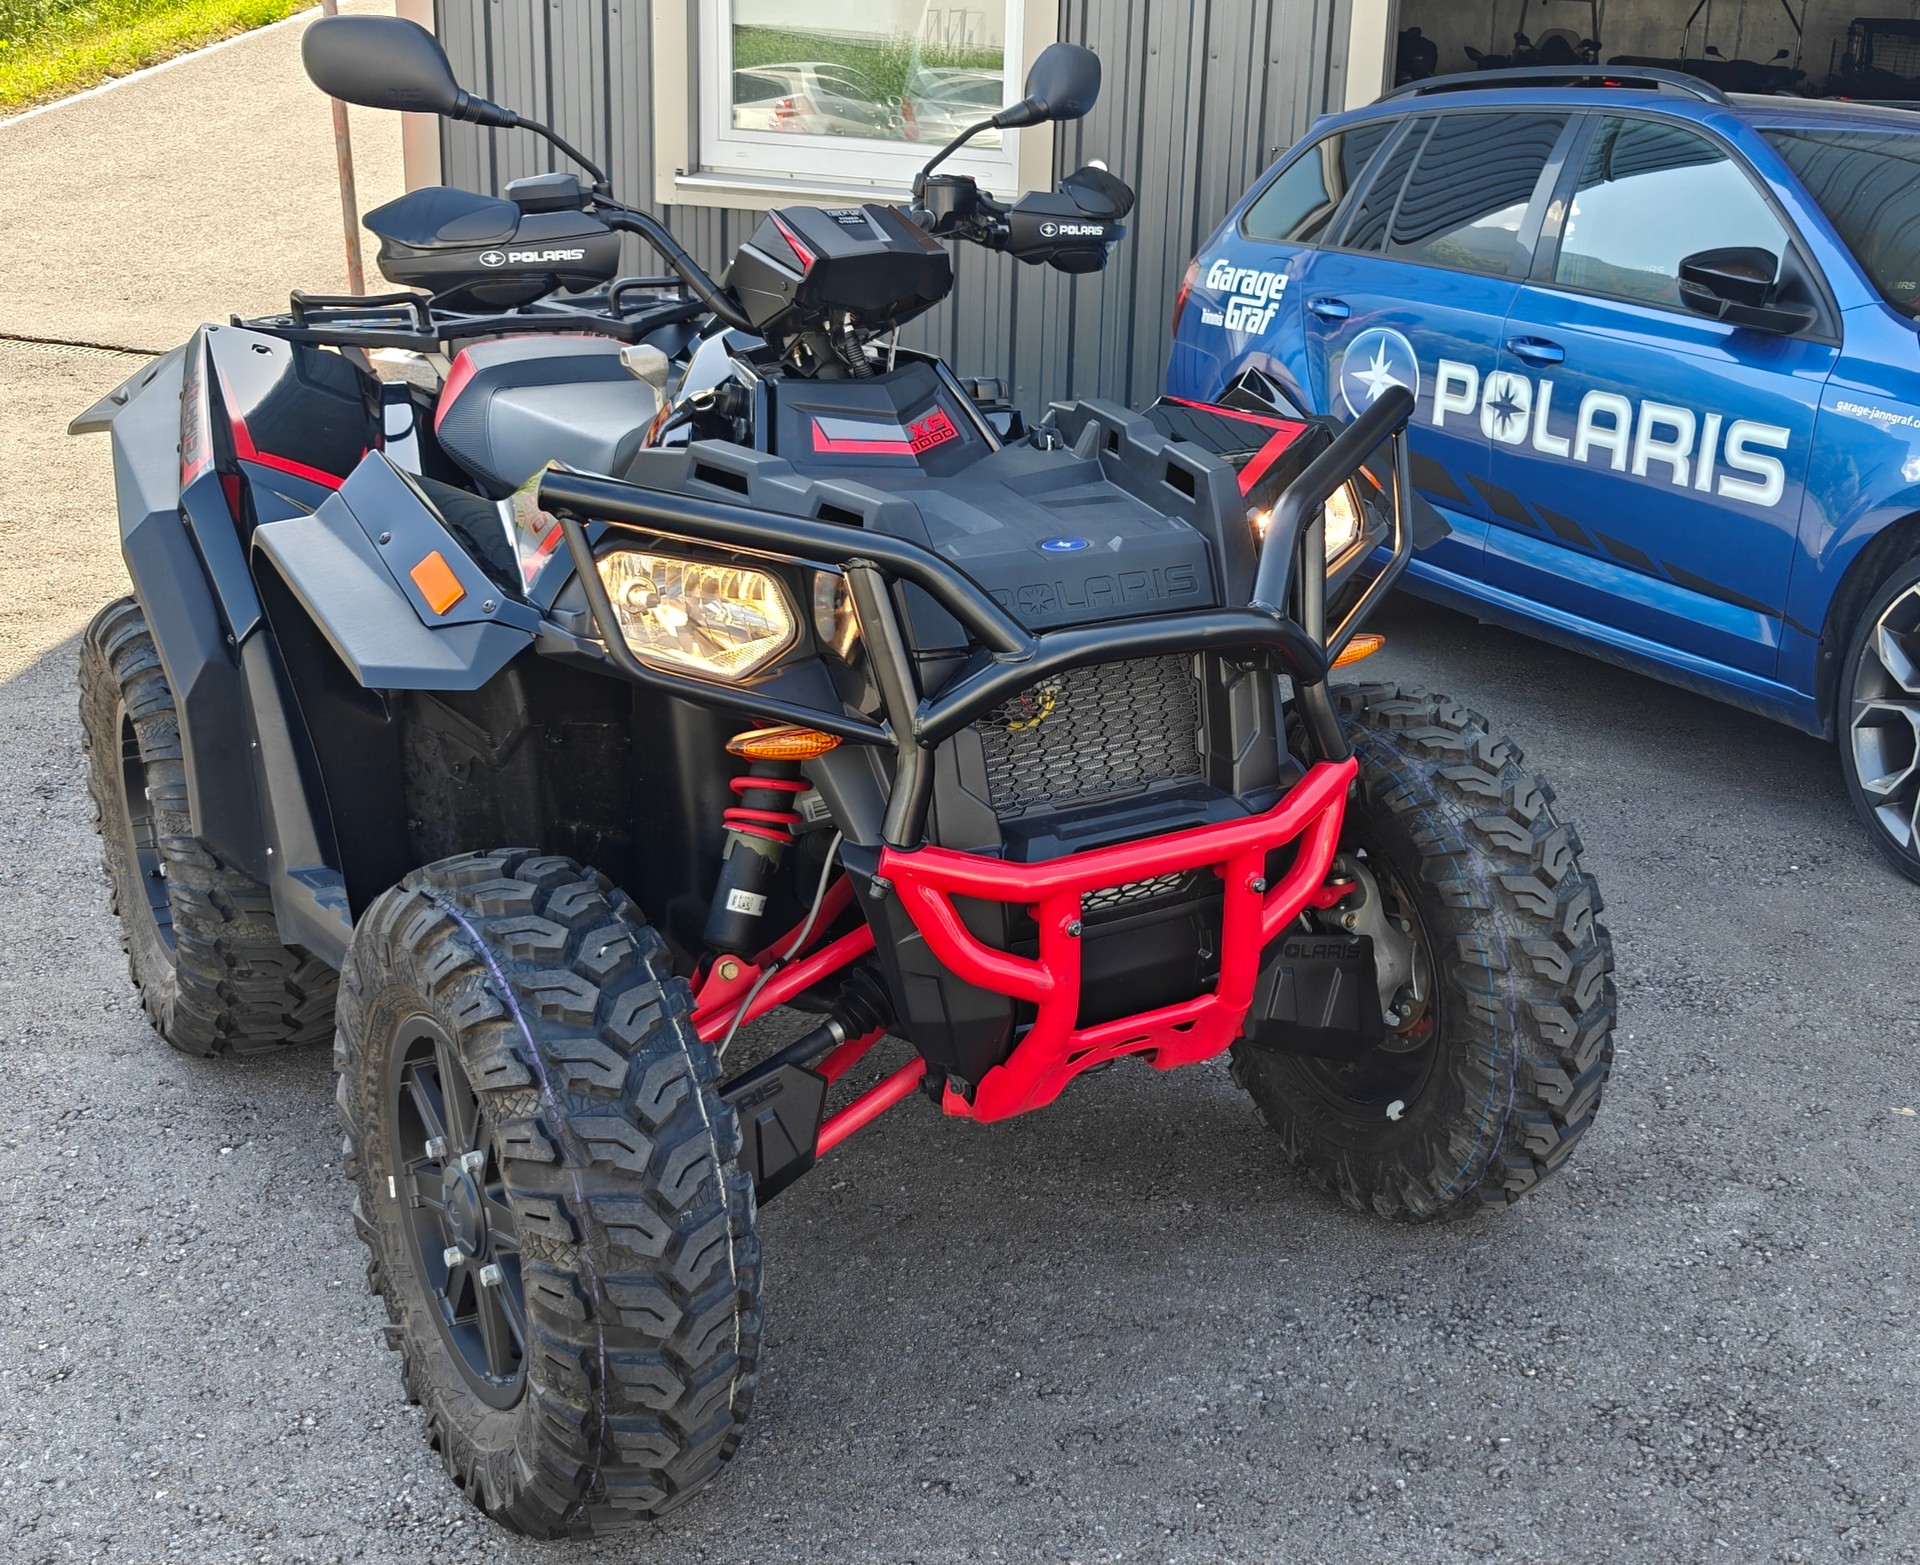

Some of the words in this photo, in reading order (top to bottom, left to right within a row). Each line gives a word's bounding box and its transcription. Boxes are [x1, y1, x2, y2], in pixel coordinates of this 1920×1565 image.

[1059, 225, 1104, 236] POLARIS
[508, 249, 585, 263] POLARIS
[1206, 259, 1289, 304] Garage
[1224, 296, 1280, 336] Graf
[1432, 358, 1791, 507] POLARIS
[1283, 944, 1361, 960] OLARIS
